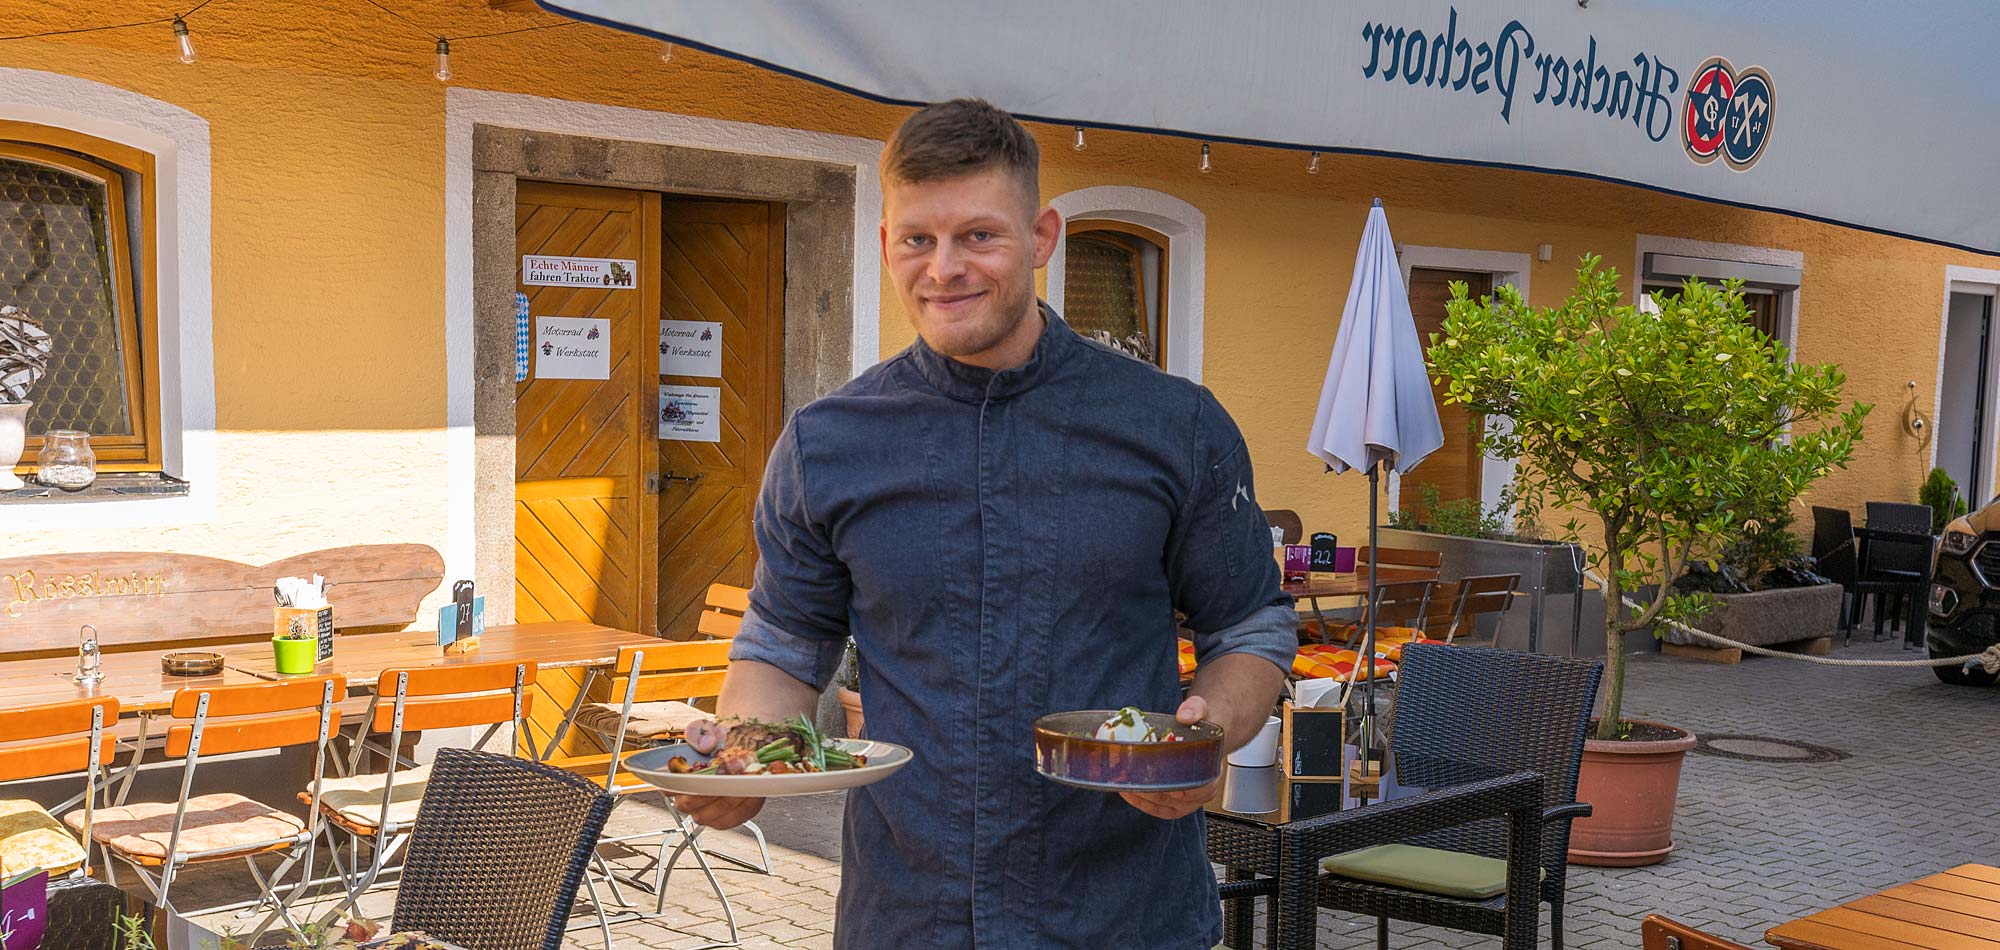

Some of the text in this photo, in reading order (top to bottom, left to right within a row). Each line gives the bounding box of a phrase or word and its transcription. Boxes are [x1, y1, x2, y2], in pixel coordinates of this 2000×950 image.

[530, 259, 599, 273] Echte Männer
[529, 271, 600, 284] fahren Traktor
[542, 325, 584, 337] Motorrad
[660, 327, 697, 338] Motorrad
[555, 346, 600, 359] Werkstatt
[671, 346, 712, 358] Werkstatt
[1313, 549, 1332, 565] 22
[2, 568, 166, 617] Rösslwirt
[459, 602, 471, 625] 27
